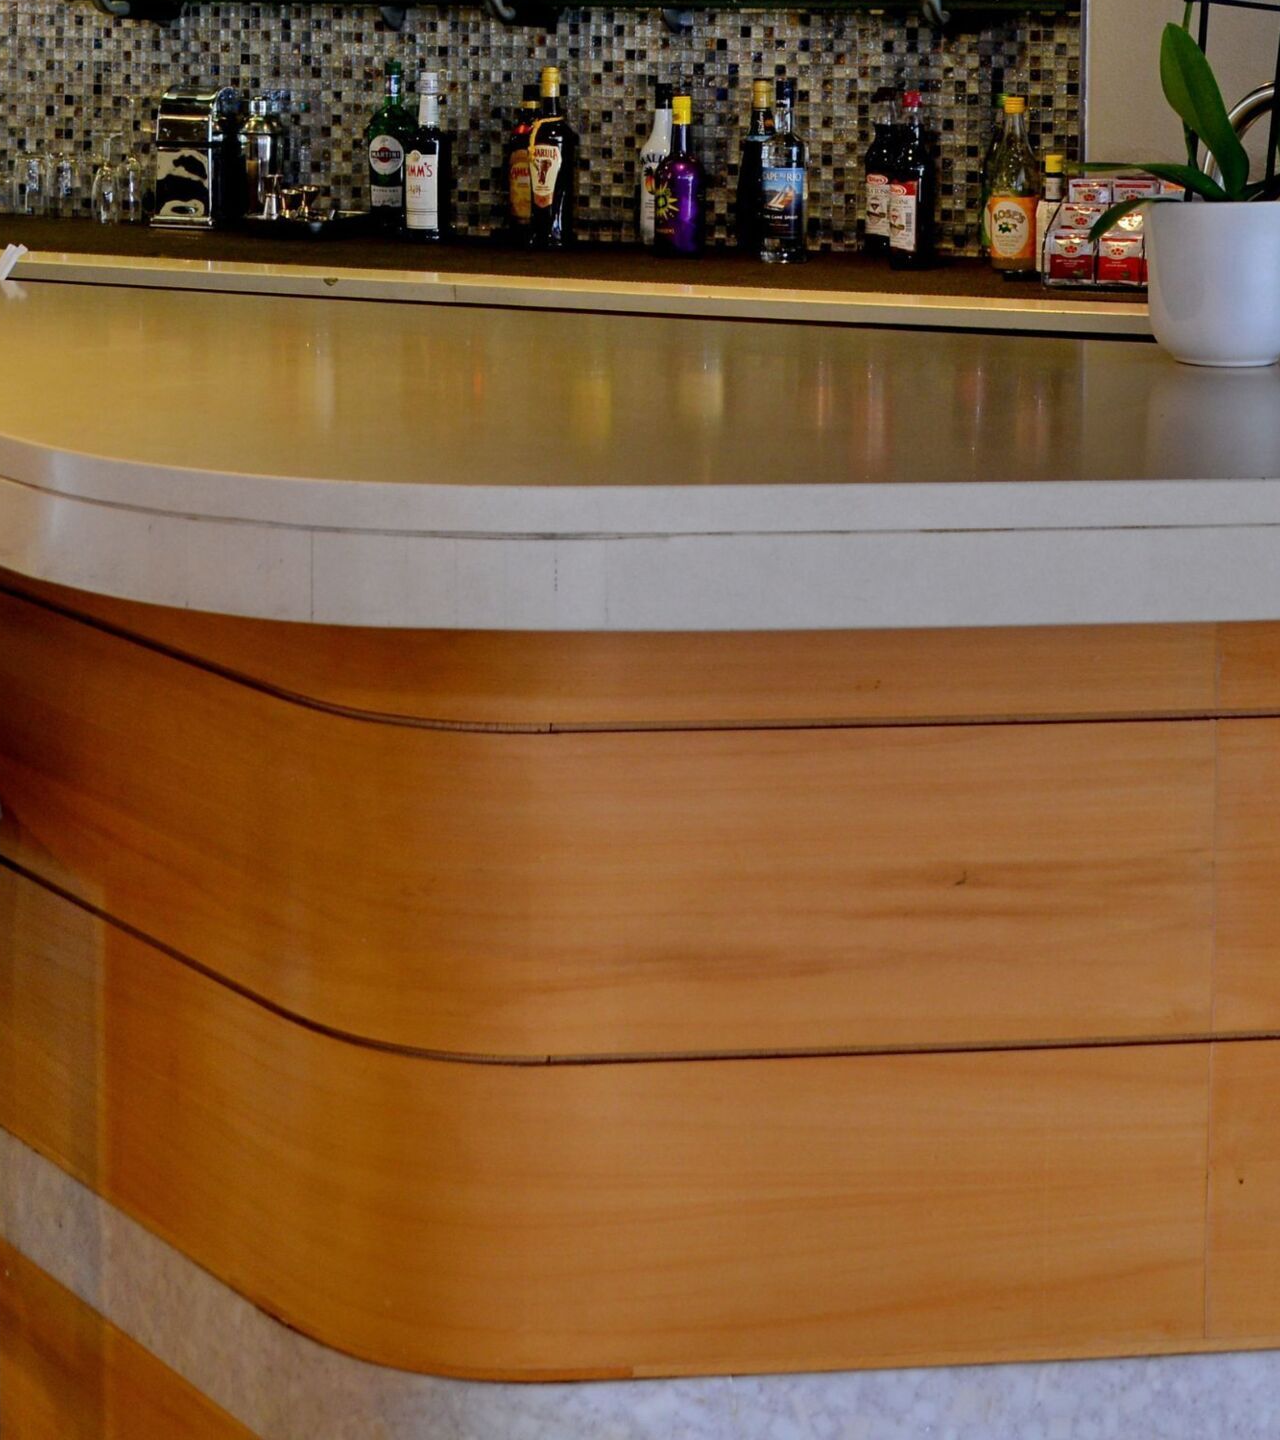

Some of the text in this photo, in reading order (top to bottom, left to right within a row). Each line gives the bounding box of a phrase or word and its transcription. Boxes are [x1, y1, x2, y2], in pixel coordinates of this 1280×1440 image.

[370, 150, 401, 159] MARTINI
[408, 162, 433, 177] IMM'S
[786, 171, 802, 182] RIO
